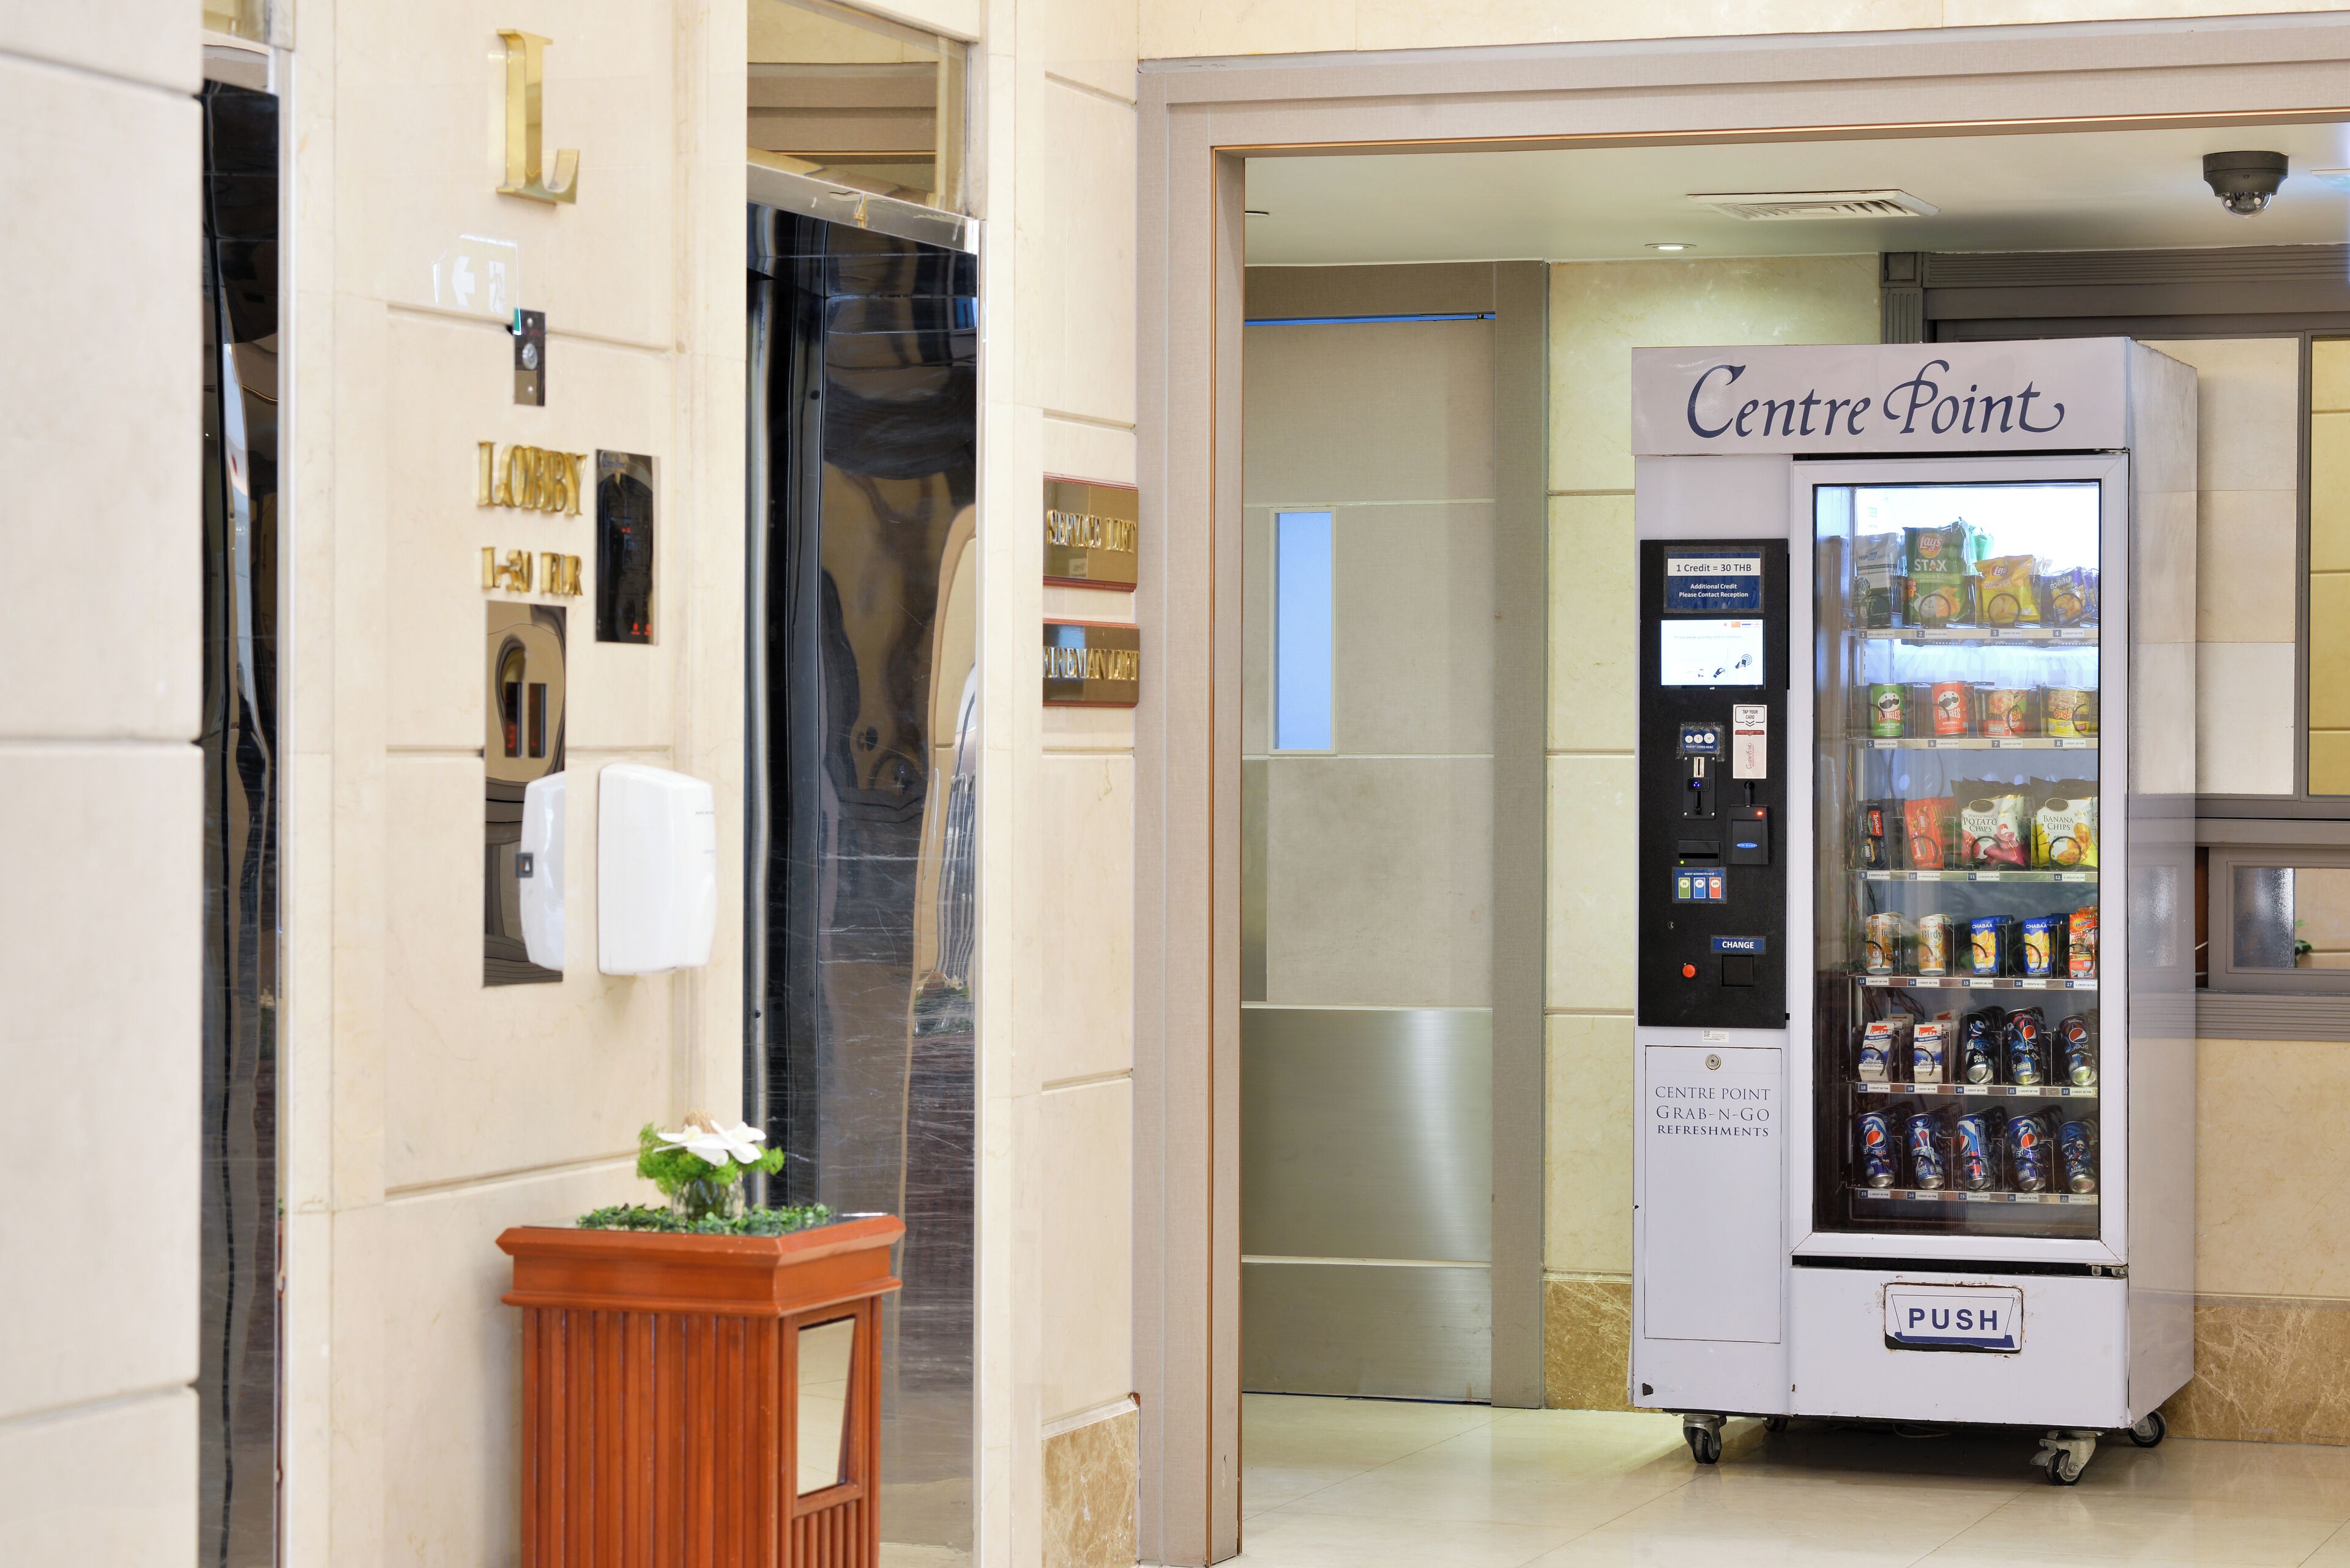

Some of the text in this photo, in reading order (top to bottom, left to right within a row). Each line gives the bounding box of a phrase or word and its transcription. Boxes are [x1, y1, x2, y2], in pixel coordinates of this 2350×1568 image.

[496, 29, 580, 205] L
[1687, 359, 2065, 439] Centre Point
[477, 441, 588, 515] LOBBY
[1047, 509, 1136, 553] SERVICE LIFT
[1919, 536, 1942, 551] Lay's
[540, 551, 583, 596] FLR
[1914, 559, 1947, 572] STAX
[1108, 650, 1140, 681] LIFT
[1878, 711, 1900, 721] PINGLES
[1963, 817, 1997, 826] POTATO
[2043, 815, 2074, 824] BANANA
[1922, 930, 1943, 941] Birdy
[1655, 1086, 1770, 1100] CENTRE POINT
[1656, 1105, 1770, 1122] GRAB-N-GO
[1657, 1124, 1769, 1137] REFRESHMENTS
[1909, 1308, 1997, 1331] PUSH
